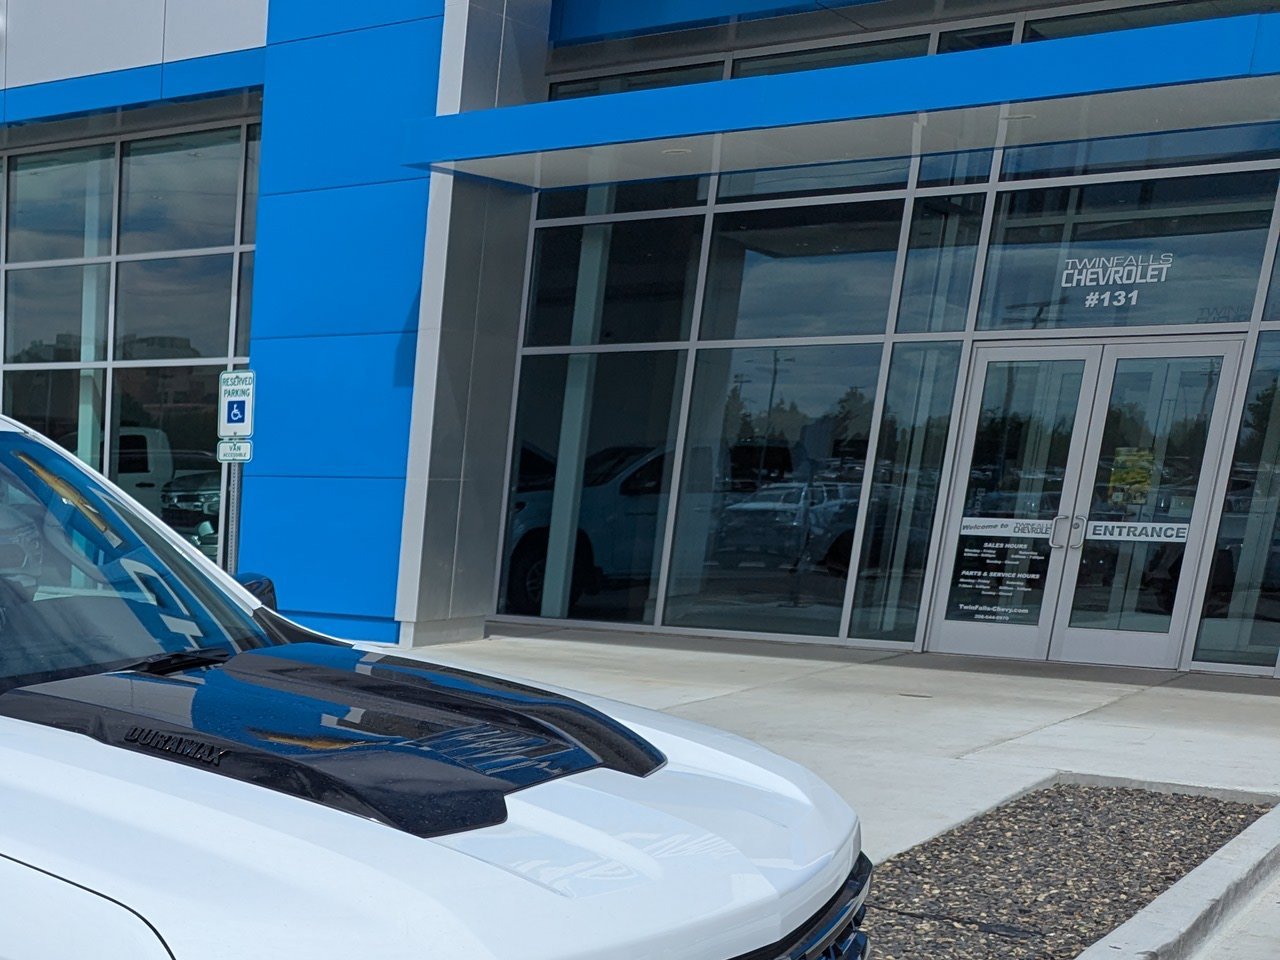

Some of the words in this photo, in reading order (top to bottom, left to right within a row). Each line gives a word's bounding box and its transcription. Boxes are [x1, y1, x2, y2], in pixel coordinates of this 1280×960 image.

[1065, 252, 1174, 270] TWINFALLS
[1061, 263, 1172, 288] CHEVROLET
[1084, 289, 1139, 308] #131
[222, 376, 253, 387] RESERVED
[223, 388, 251, 398] PARKING
[229, 444, 241, 452] VAN
[1091, 525, 1187, 539] ENTRANCE
[123, 727, 222, 767] DURAMAX
